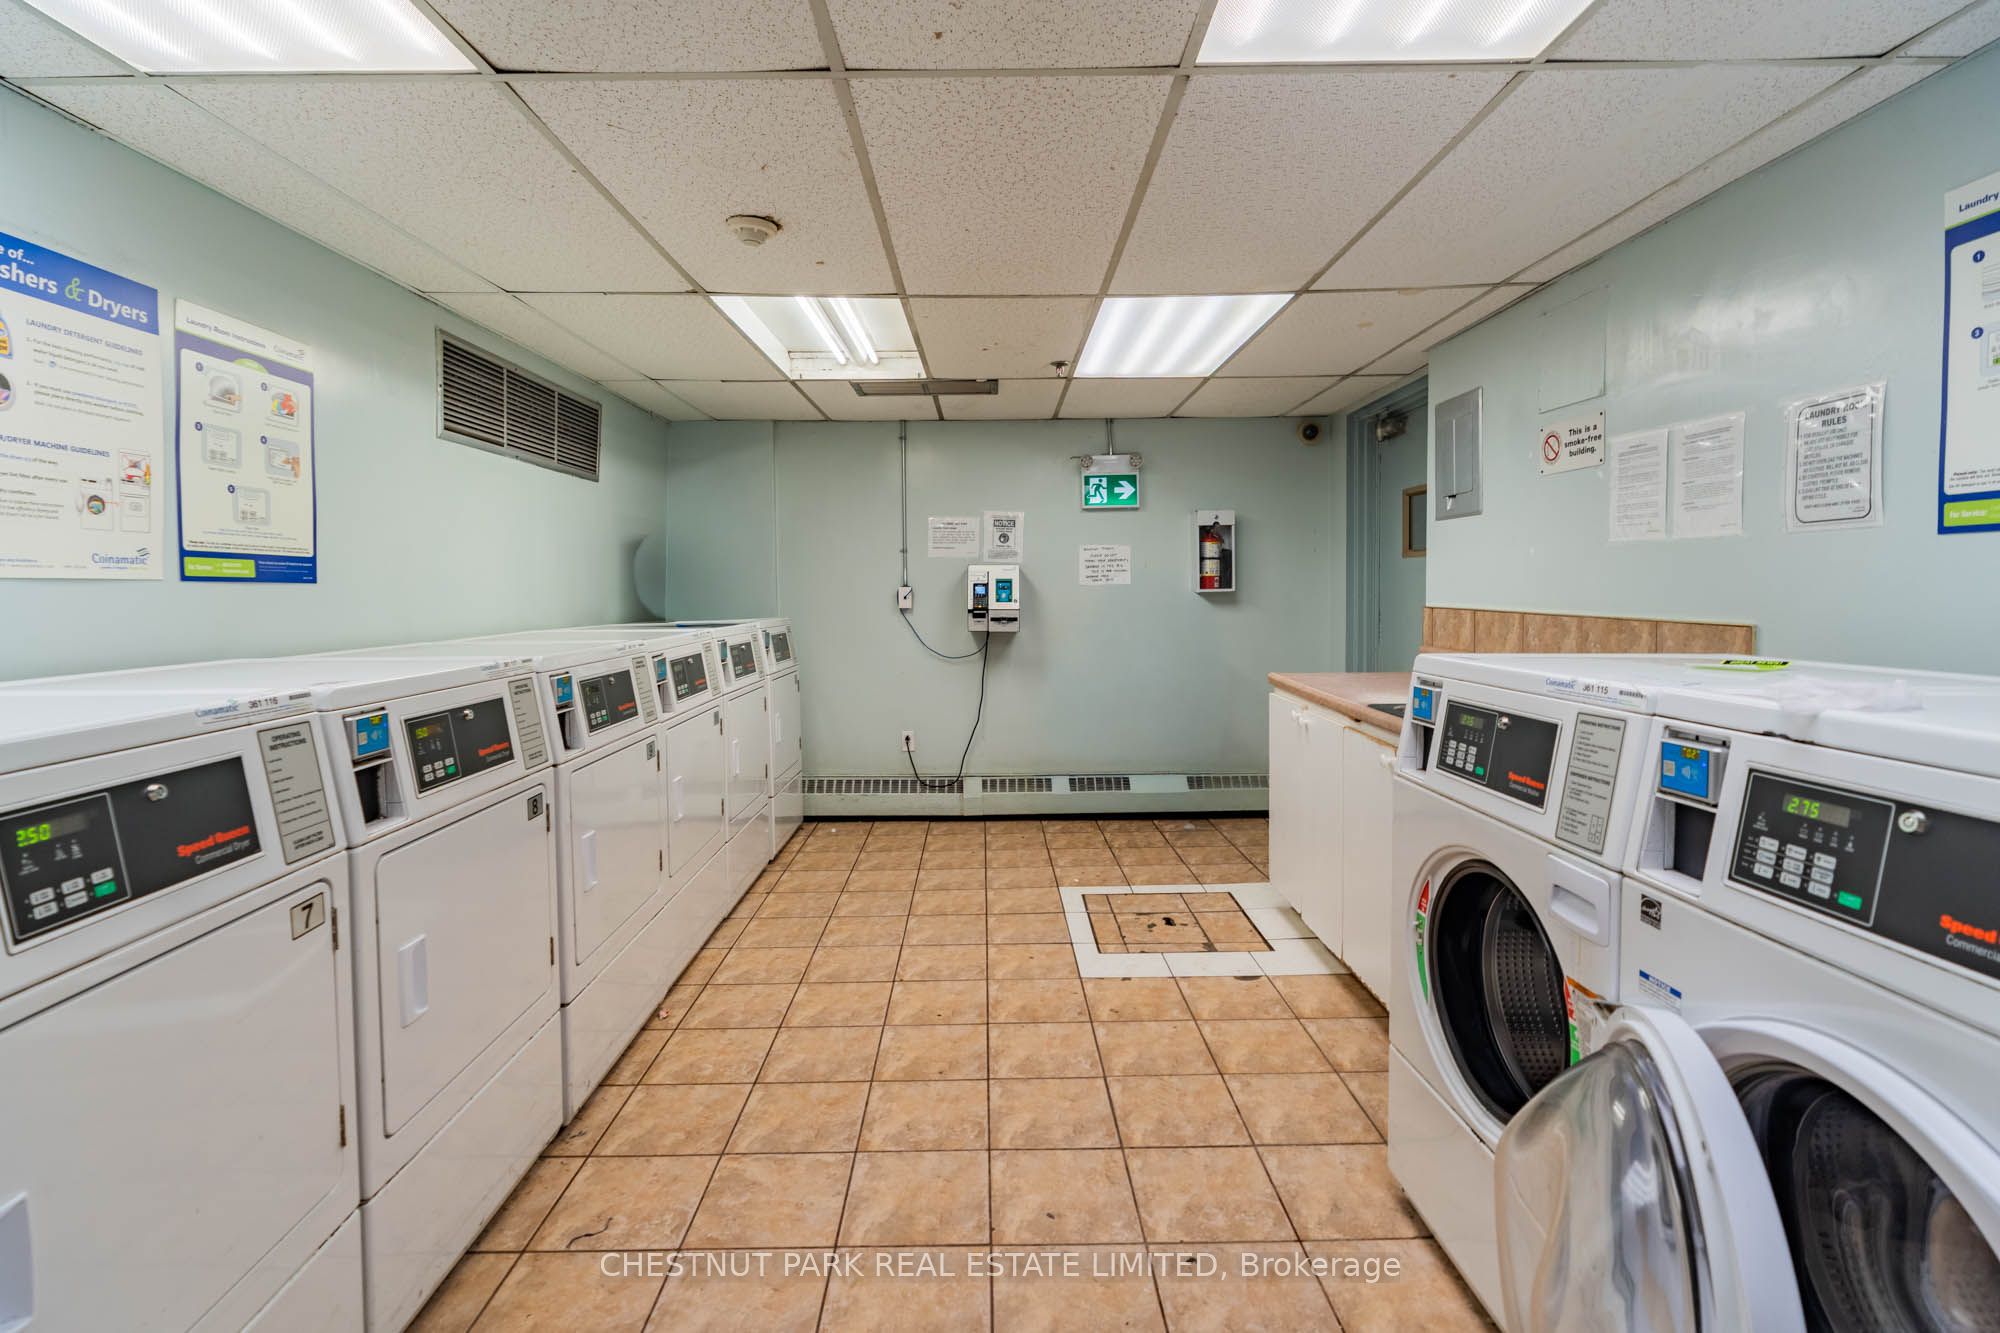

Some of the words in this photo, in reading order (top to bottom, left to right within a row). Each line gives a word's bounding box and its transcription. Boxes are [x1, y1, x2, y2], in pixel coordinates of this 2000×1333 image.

[1959, 192, 1999, 212] Laundry
[0, 263, 59, 295] shers
[65, 277, 86, 302] &
[88, 289, 149, 324] Dryers
[26, 318, 63, 335] LAUNDRY
[1822, 415, 1847, 428] RULES
[1569, 427, 1583, 437] This
[1584, 425, 1591, 433] is
[33, 440, 69, 451] MACHINE
[1564, 434, 1602, 448] smoke-free
[1569, 446, 1597, 457] building.
[92, 552, 148, 566] Coinamatic
[532, 798, 539, 815] 8
[176, 835, 215, 857] Speed
[301, 902, 313, 930] 7
[1940, 913, 1997, 945] Speed
